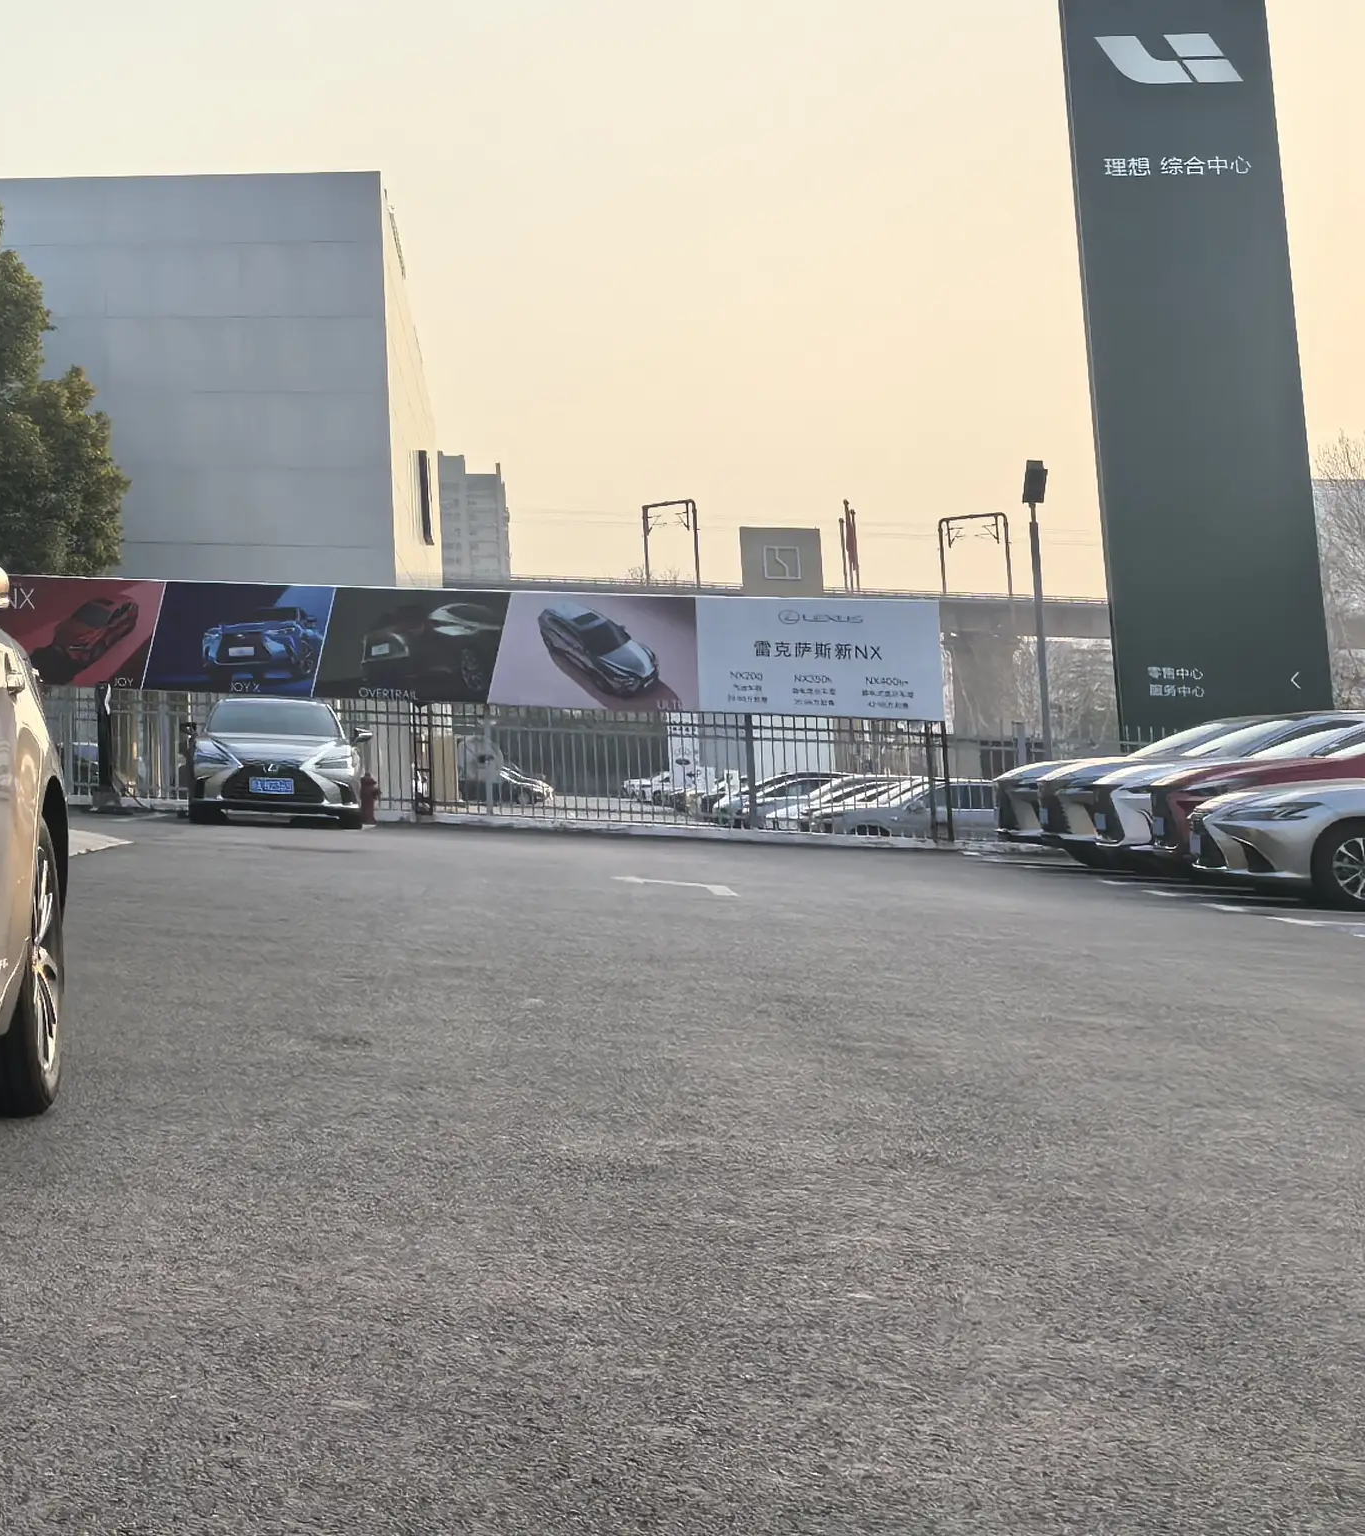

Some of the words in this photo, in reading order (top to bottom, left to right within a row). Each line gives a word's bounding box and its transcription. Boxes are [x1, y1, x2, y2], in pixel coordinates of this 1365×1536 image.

[1103, 156, 1151, 177] 理想
[1160, 155, 1252, 176] 综合中心
[802, 613, 864, 624] LEXUS
[754, 640, 883, 661] 雷克萨斯新NX
[113, 677, 134, 687] JOY
[358, 686, 419, 701] OVERTRAIL
